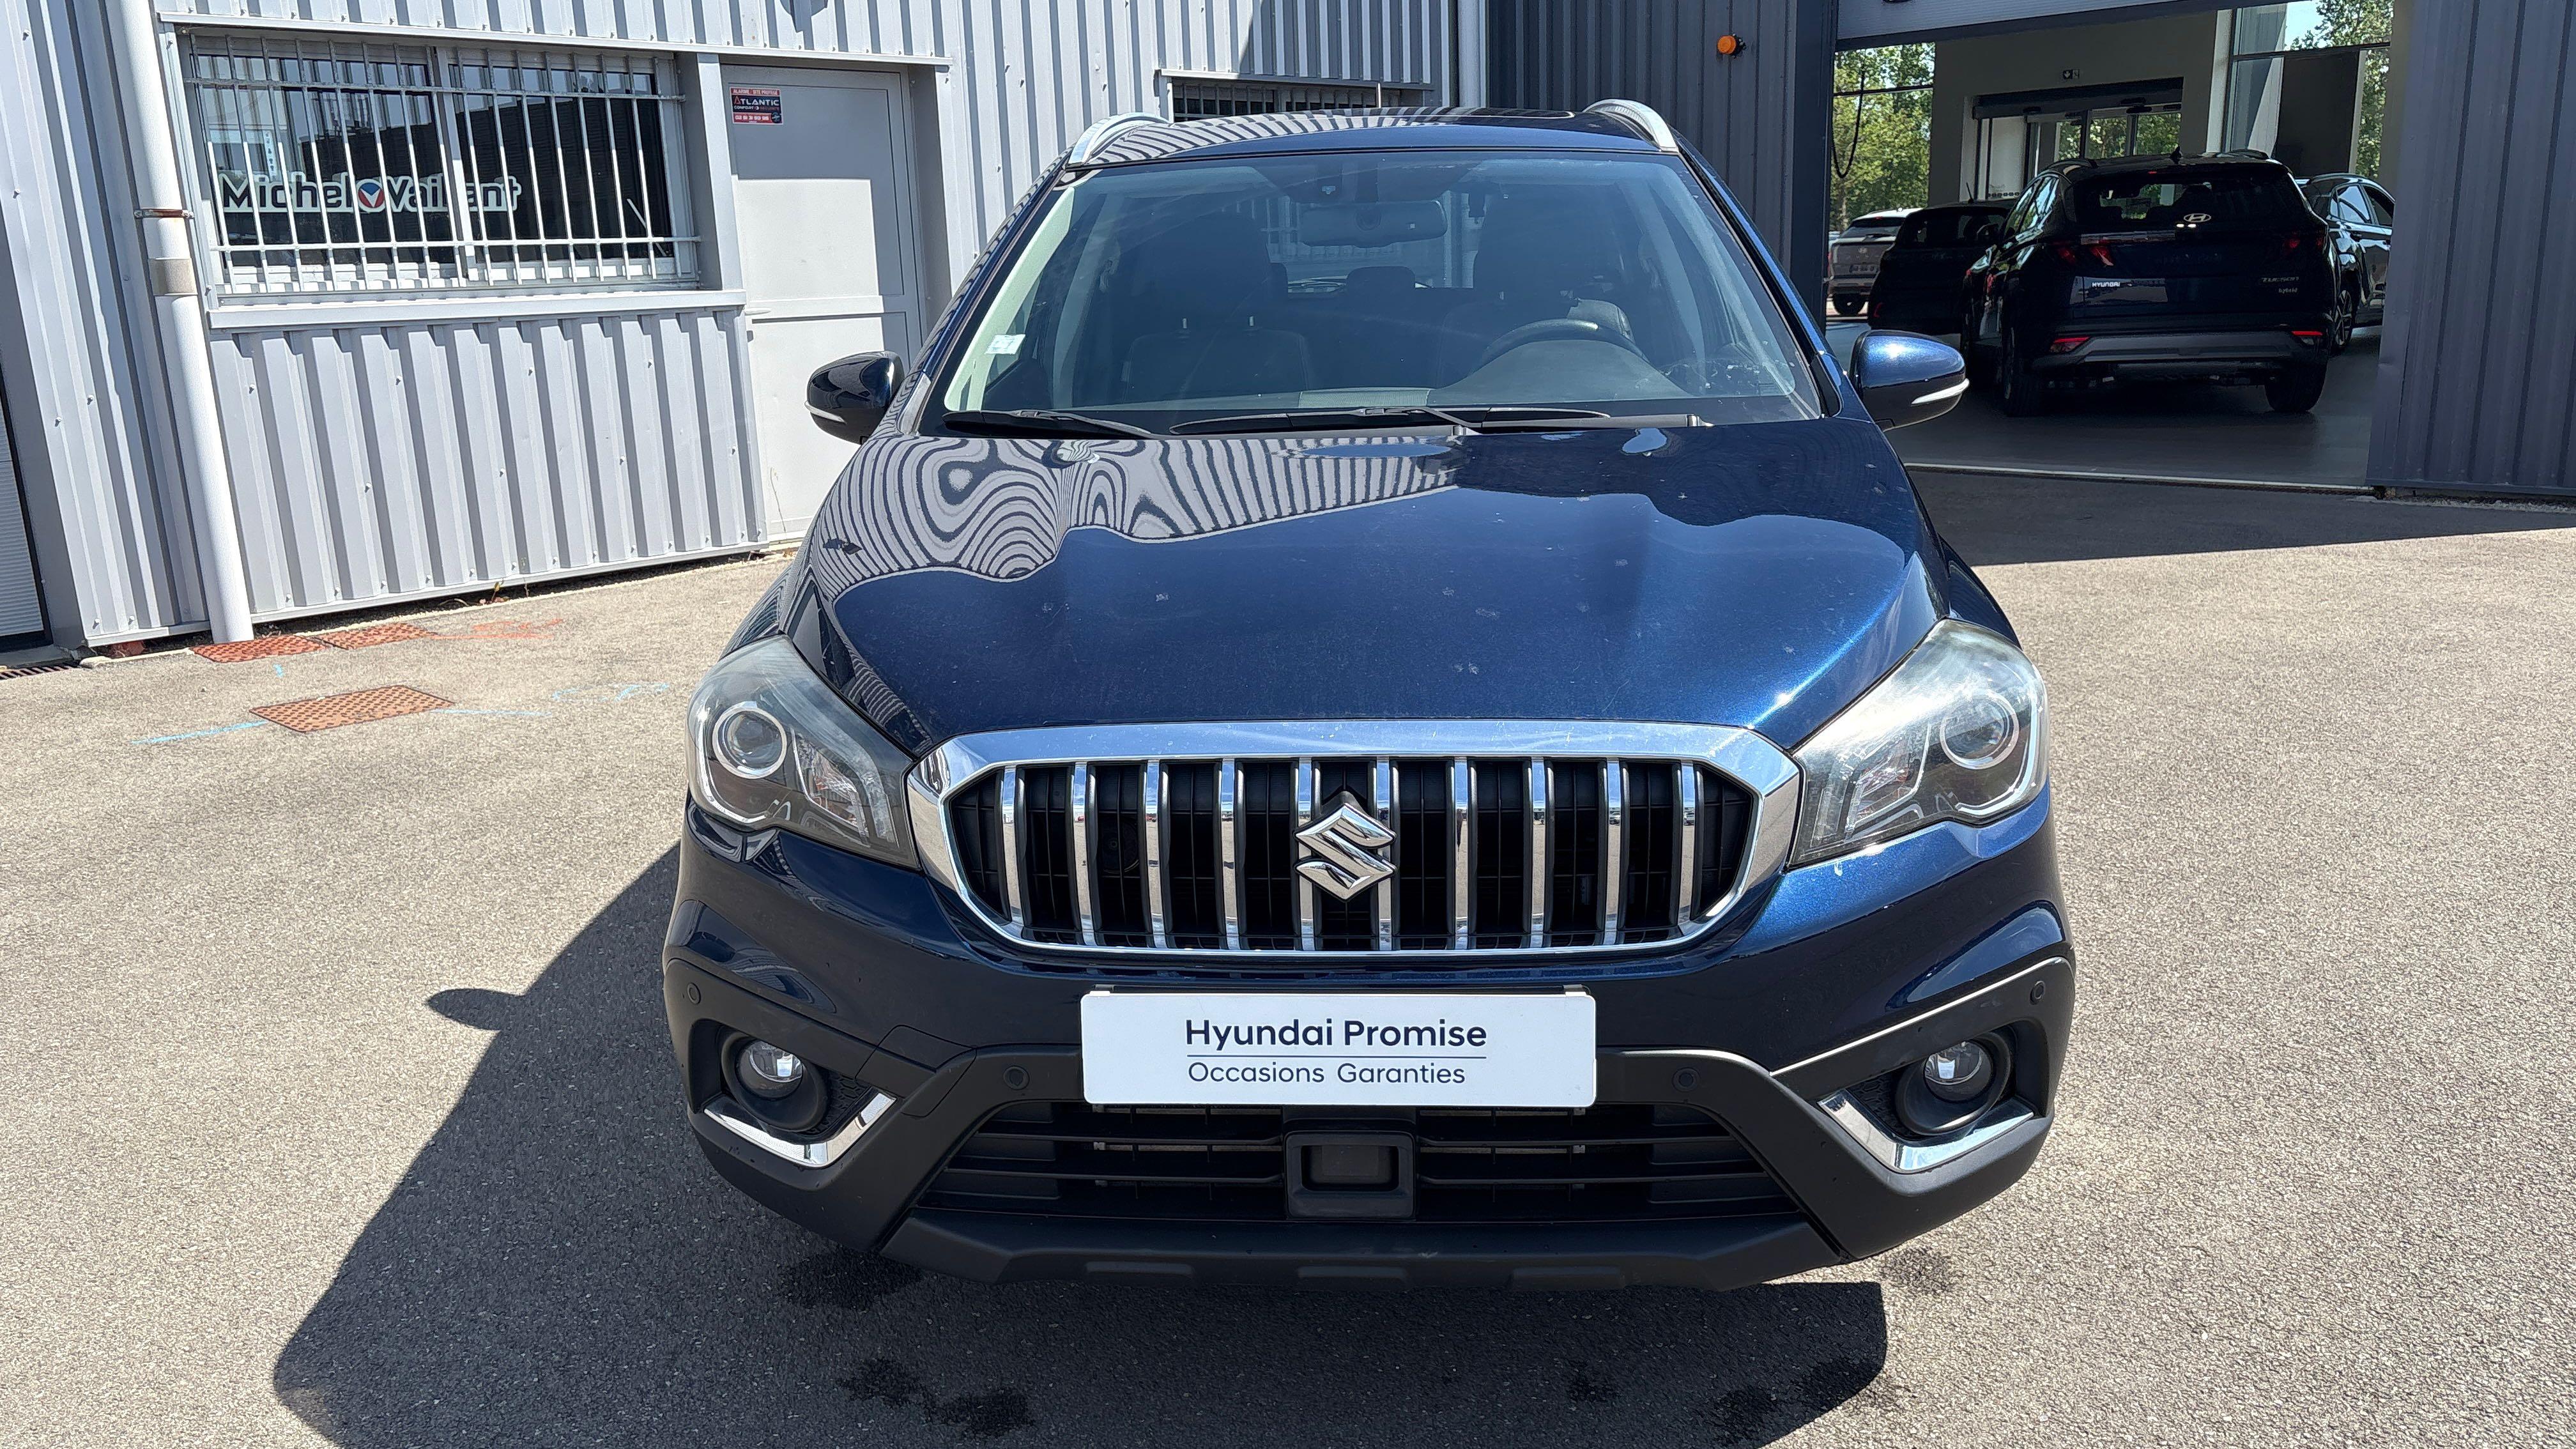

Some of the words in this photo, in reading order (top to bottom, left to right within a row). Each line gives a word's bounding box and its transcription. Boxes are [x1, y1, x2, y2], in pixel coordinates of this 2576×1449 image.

[733, 95, 779, 106] ATLANTIC
[220, 172, 355, 211] Michel
[386, 174, 521, 211] Vailant
[1186, 1018, 1333, 1051] Hyundai
[1344, 1019, 1487, 1046] Promise
[1188, 1061, 1324, 1082] Occasions
[1337, 1062, 1465, 1084] Garanties
